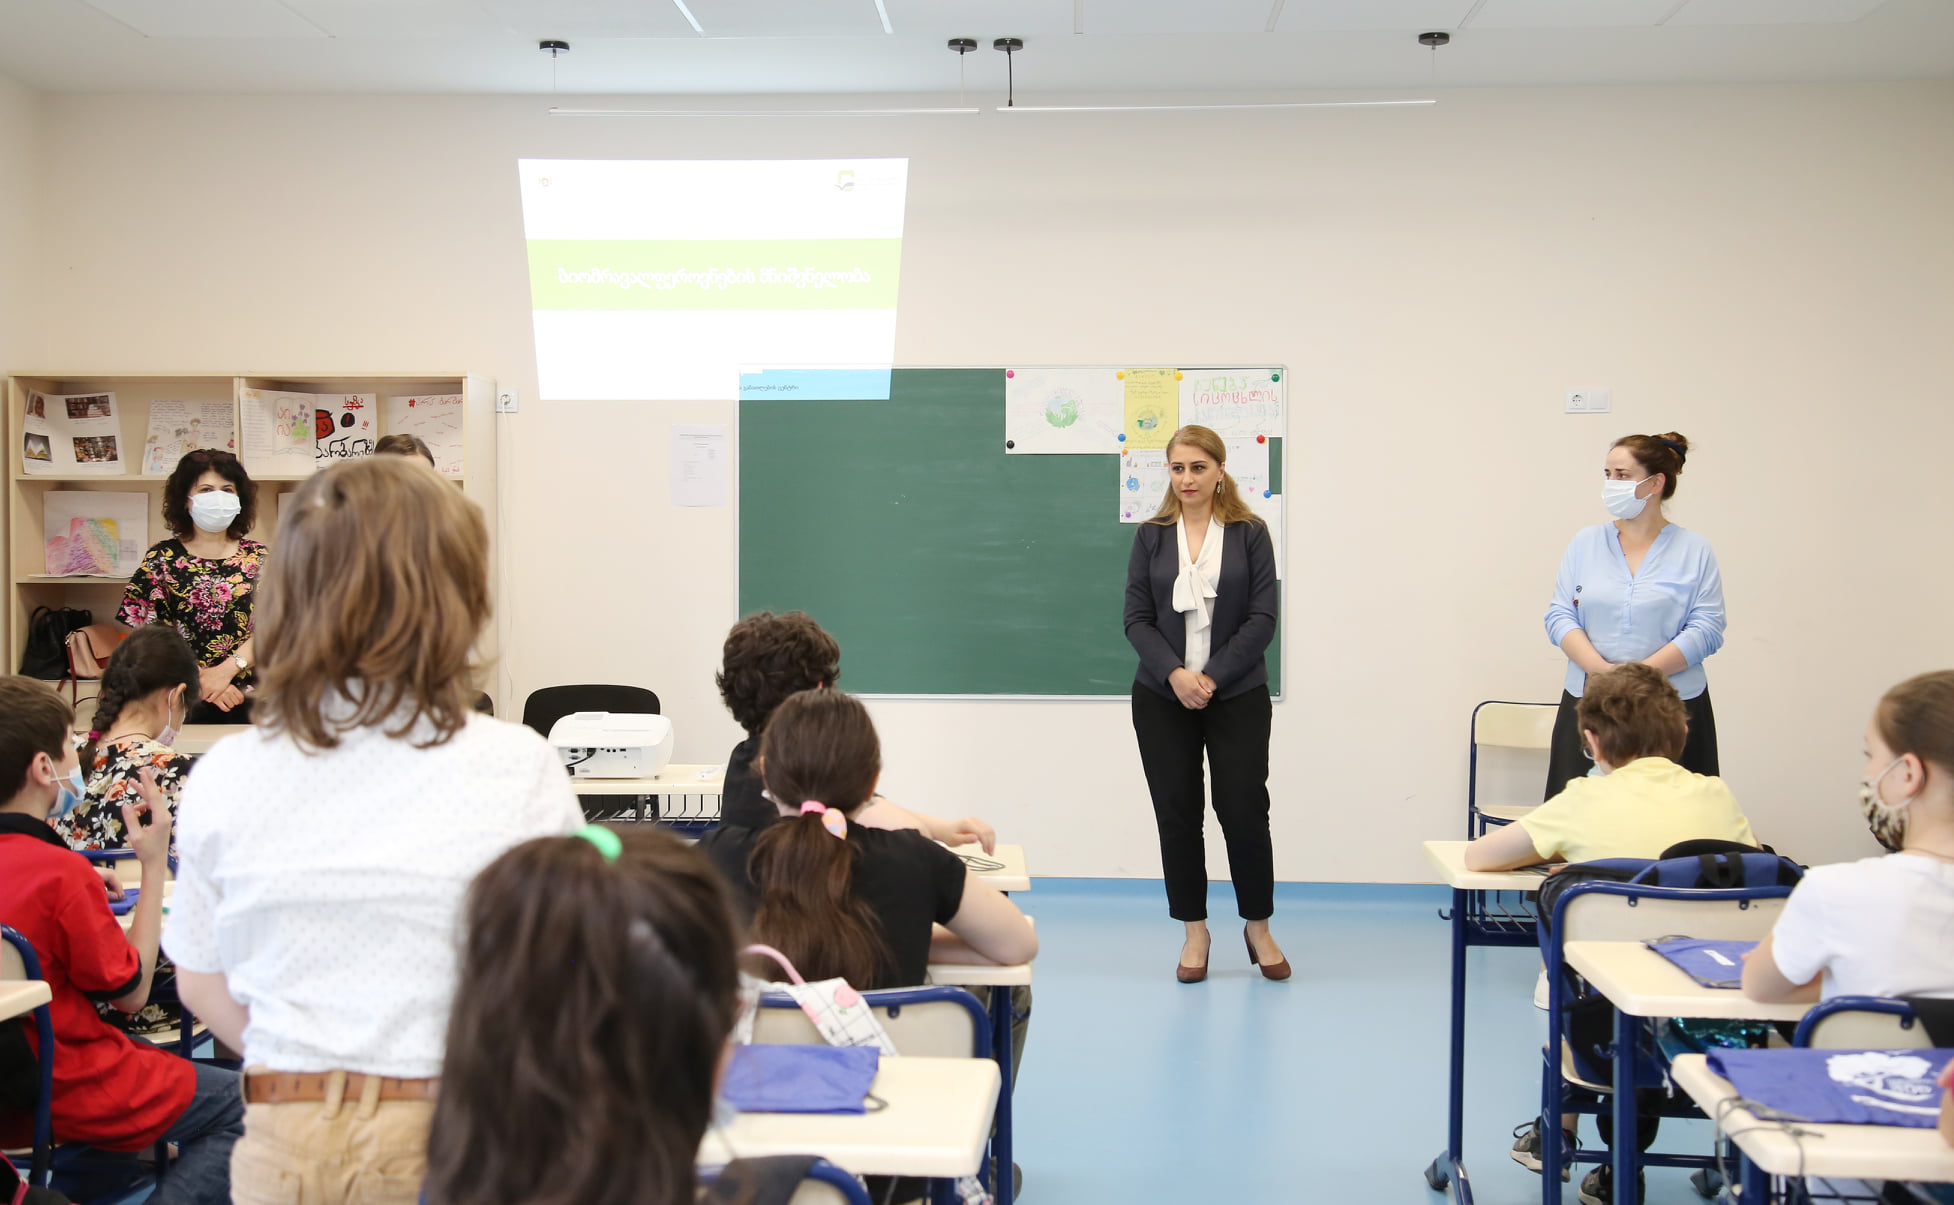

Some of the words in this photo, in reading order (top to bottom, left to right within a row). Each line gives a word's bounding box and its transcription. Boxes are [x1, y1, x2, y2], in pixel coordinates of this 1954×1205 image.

[558, 266, 755, 289] ბიომრავალფეროვნების
[759, 266, 872, 289] მნიშვნელობა
[1193, 389, 1278, 406] სიცოცხლის
